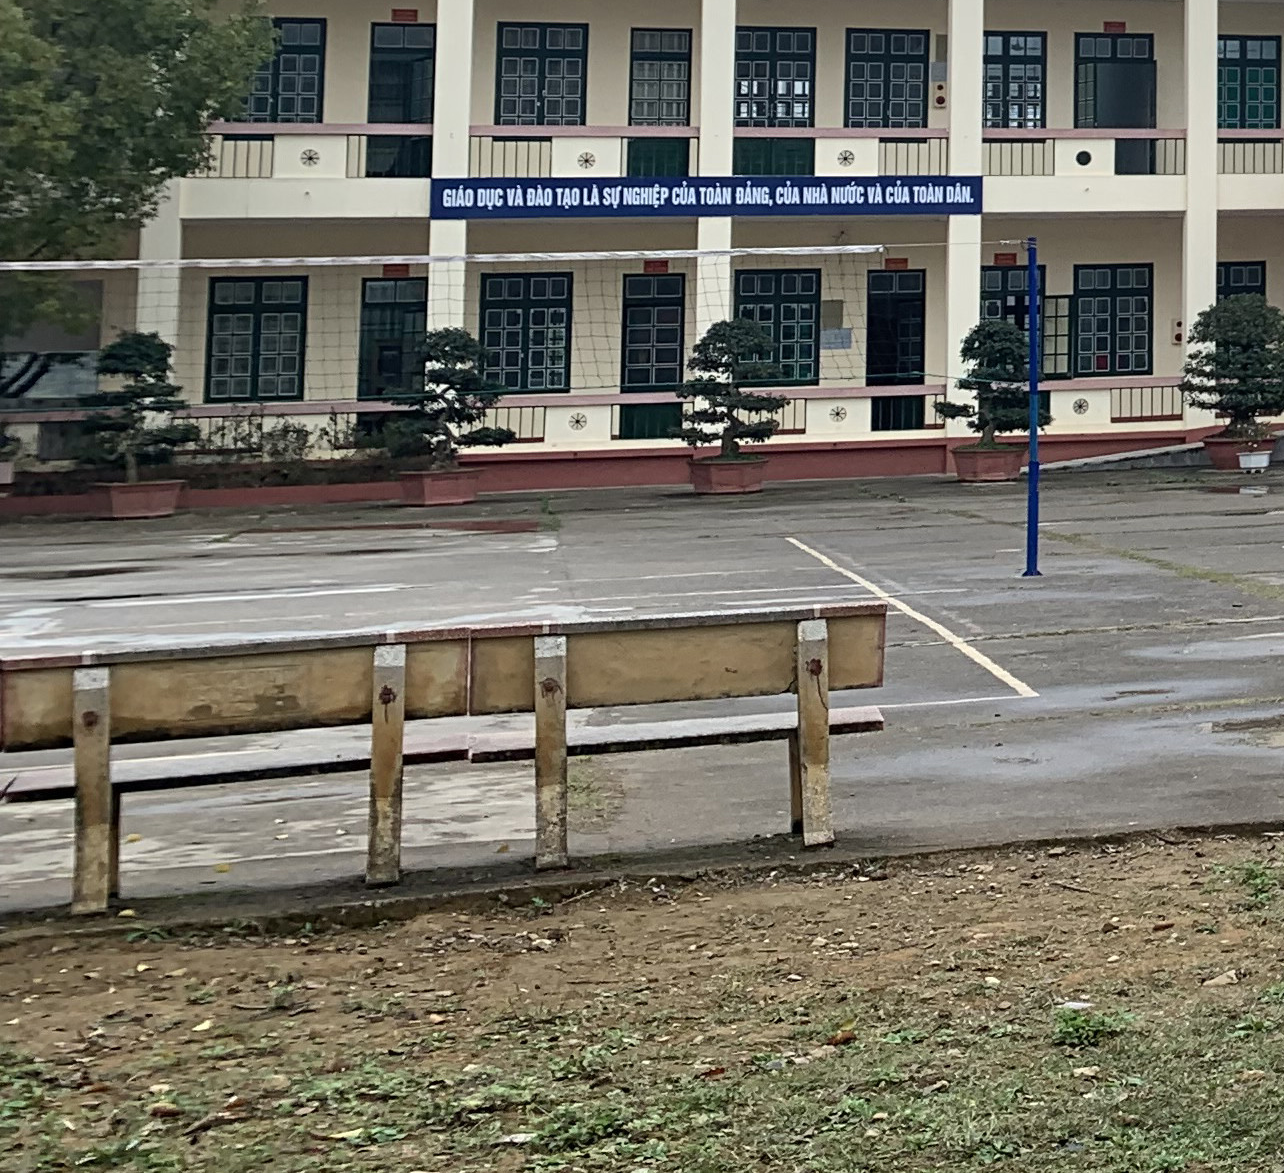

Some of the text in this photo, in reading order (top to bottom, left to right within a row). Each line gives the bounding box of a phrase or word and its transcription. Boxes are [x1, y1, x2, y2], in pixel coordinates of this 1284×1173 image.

[442, 180, 975, 210] GIÁO DỤC VÀ ĐÀO TẠO LÀ SỰ NGHIỆP CỦA TOÀN ĐẢNG, CỦA NHÀ NƯỚC VÀ CỦA TOÀN DÂN.
